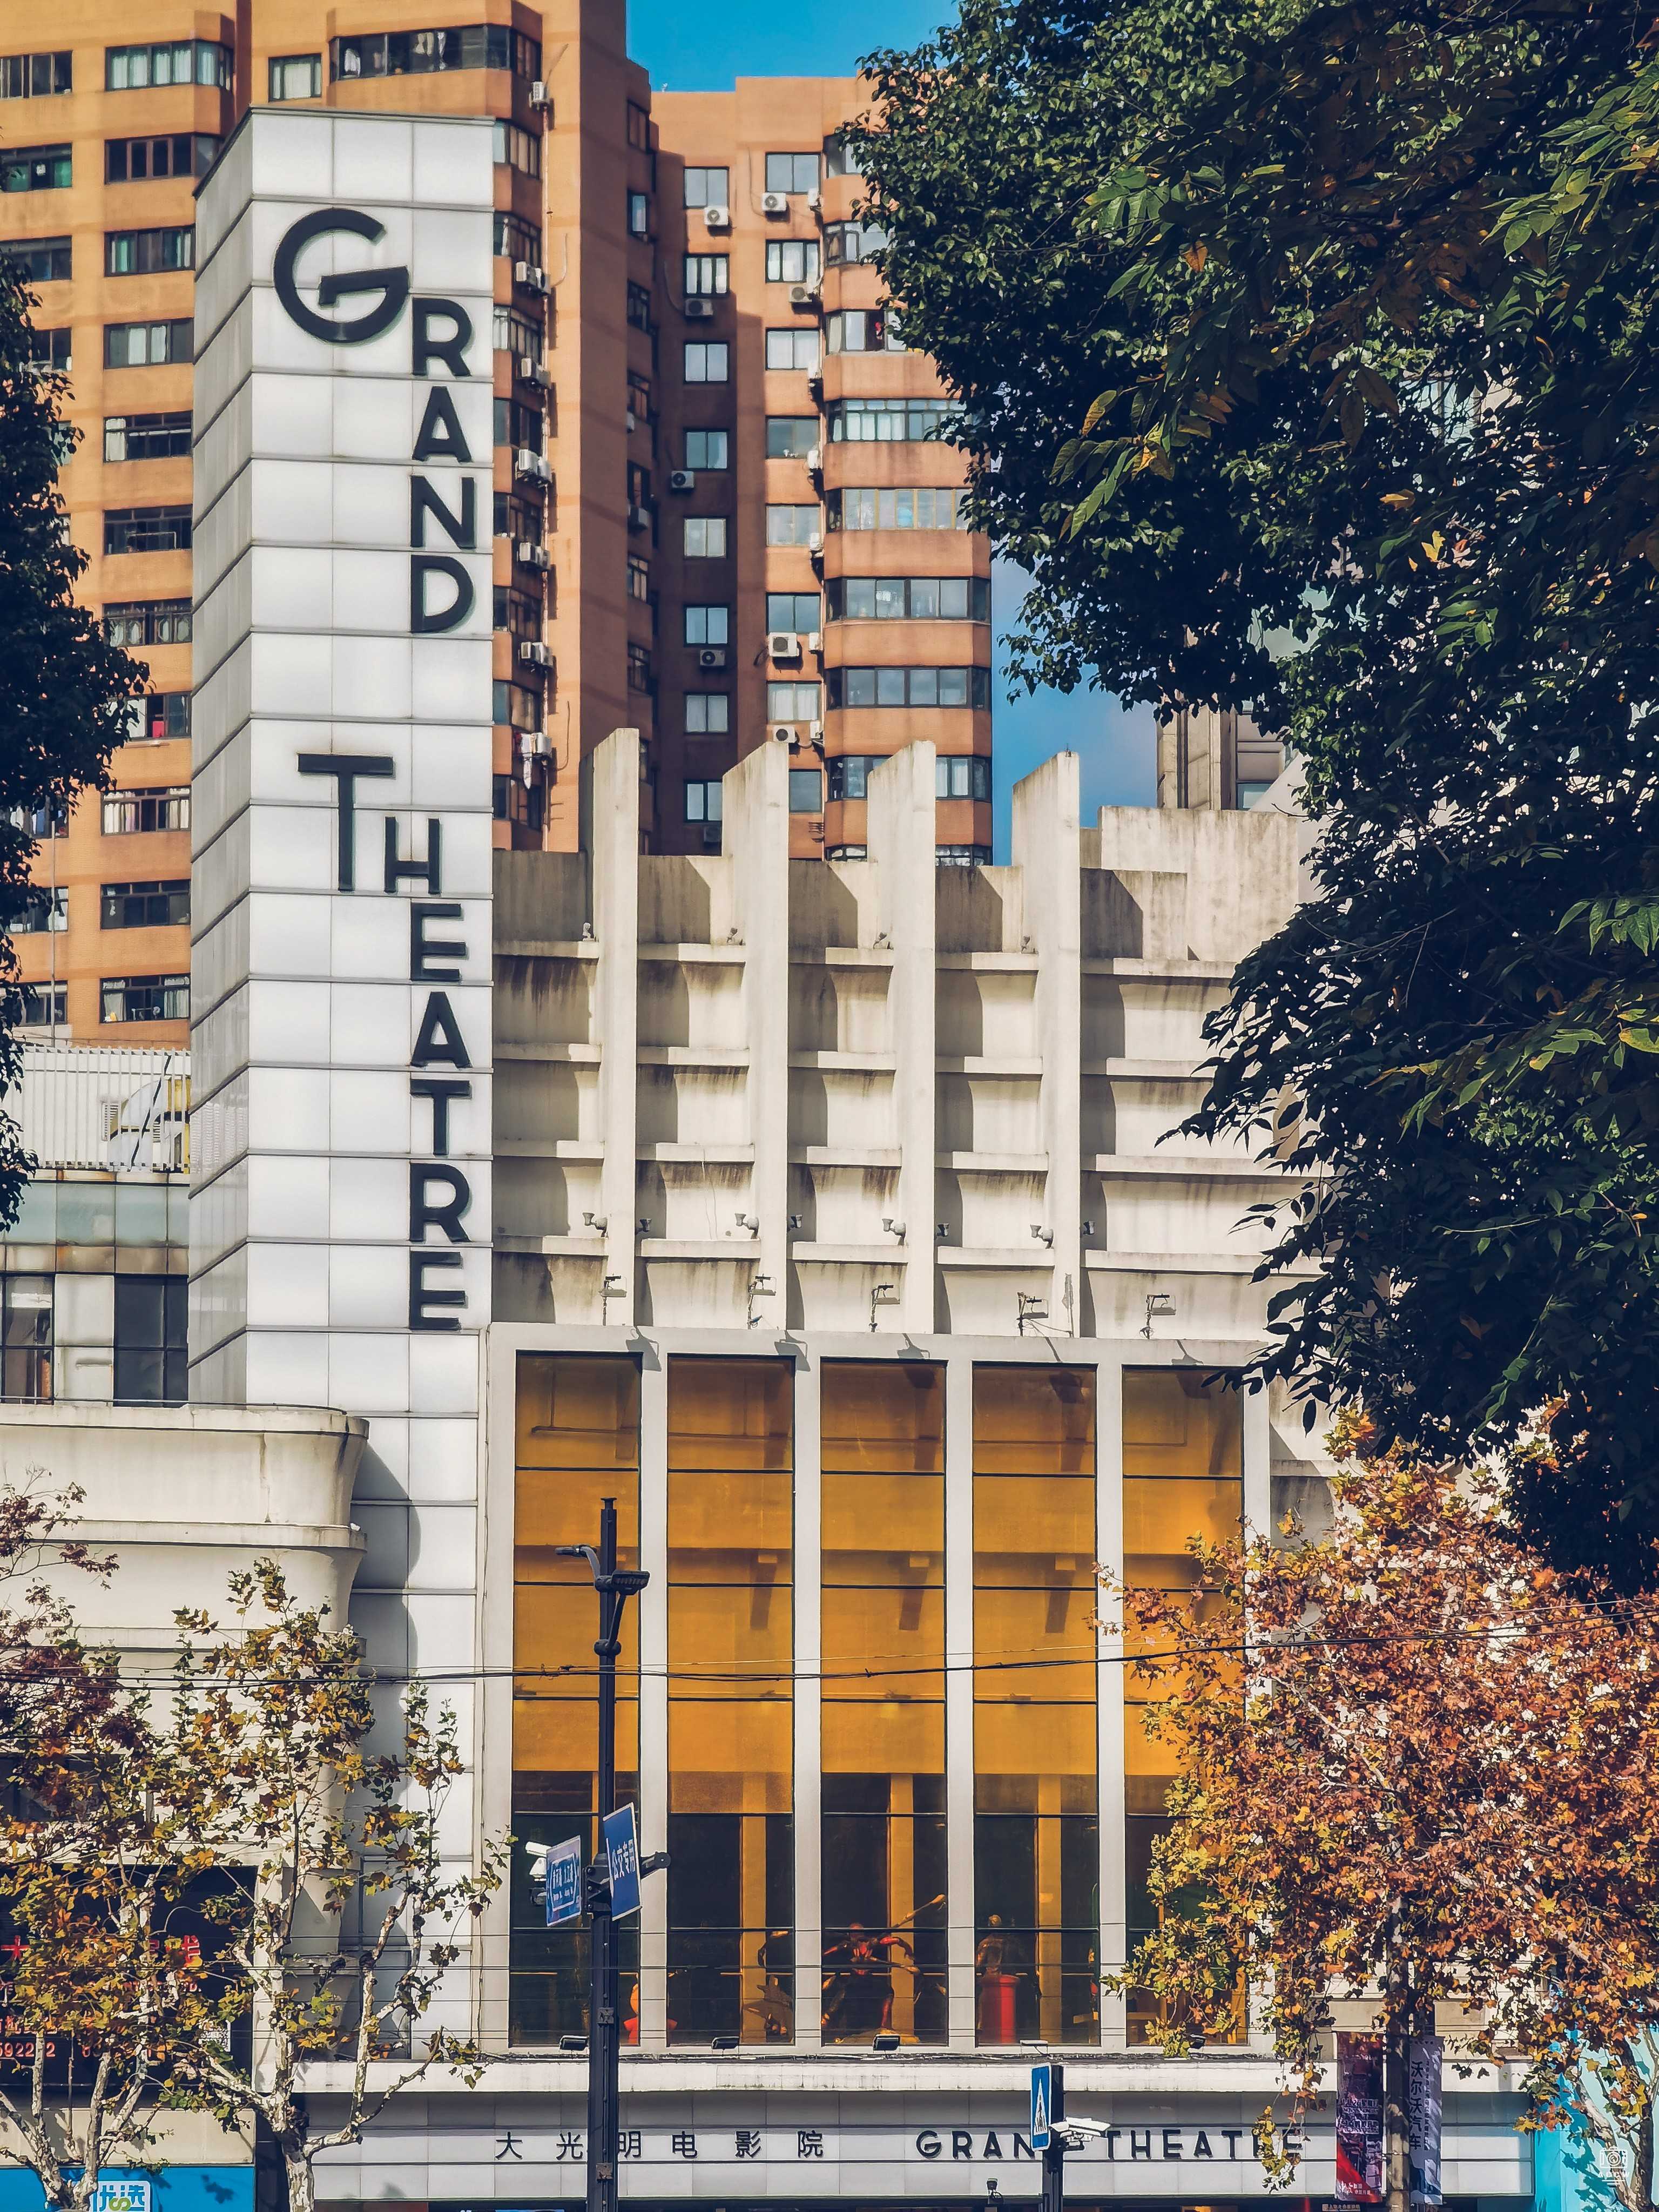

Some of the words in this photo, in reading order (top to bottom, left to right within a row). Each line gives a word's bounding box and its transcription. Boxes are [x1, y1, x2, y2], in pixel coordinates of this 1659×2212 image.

[273, 207, 476, 634] GRAND
[298, 752, 474, 1331] THEATRE
[495, 2130, 825, 2160] 大光明电影院
[916, 2130, 1036, 2159] GRAN
[1106, 2129, 1303, 2160] THEATE
[1410, 2060, 1424, 2150] 沃尔沃汽车
